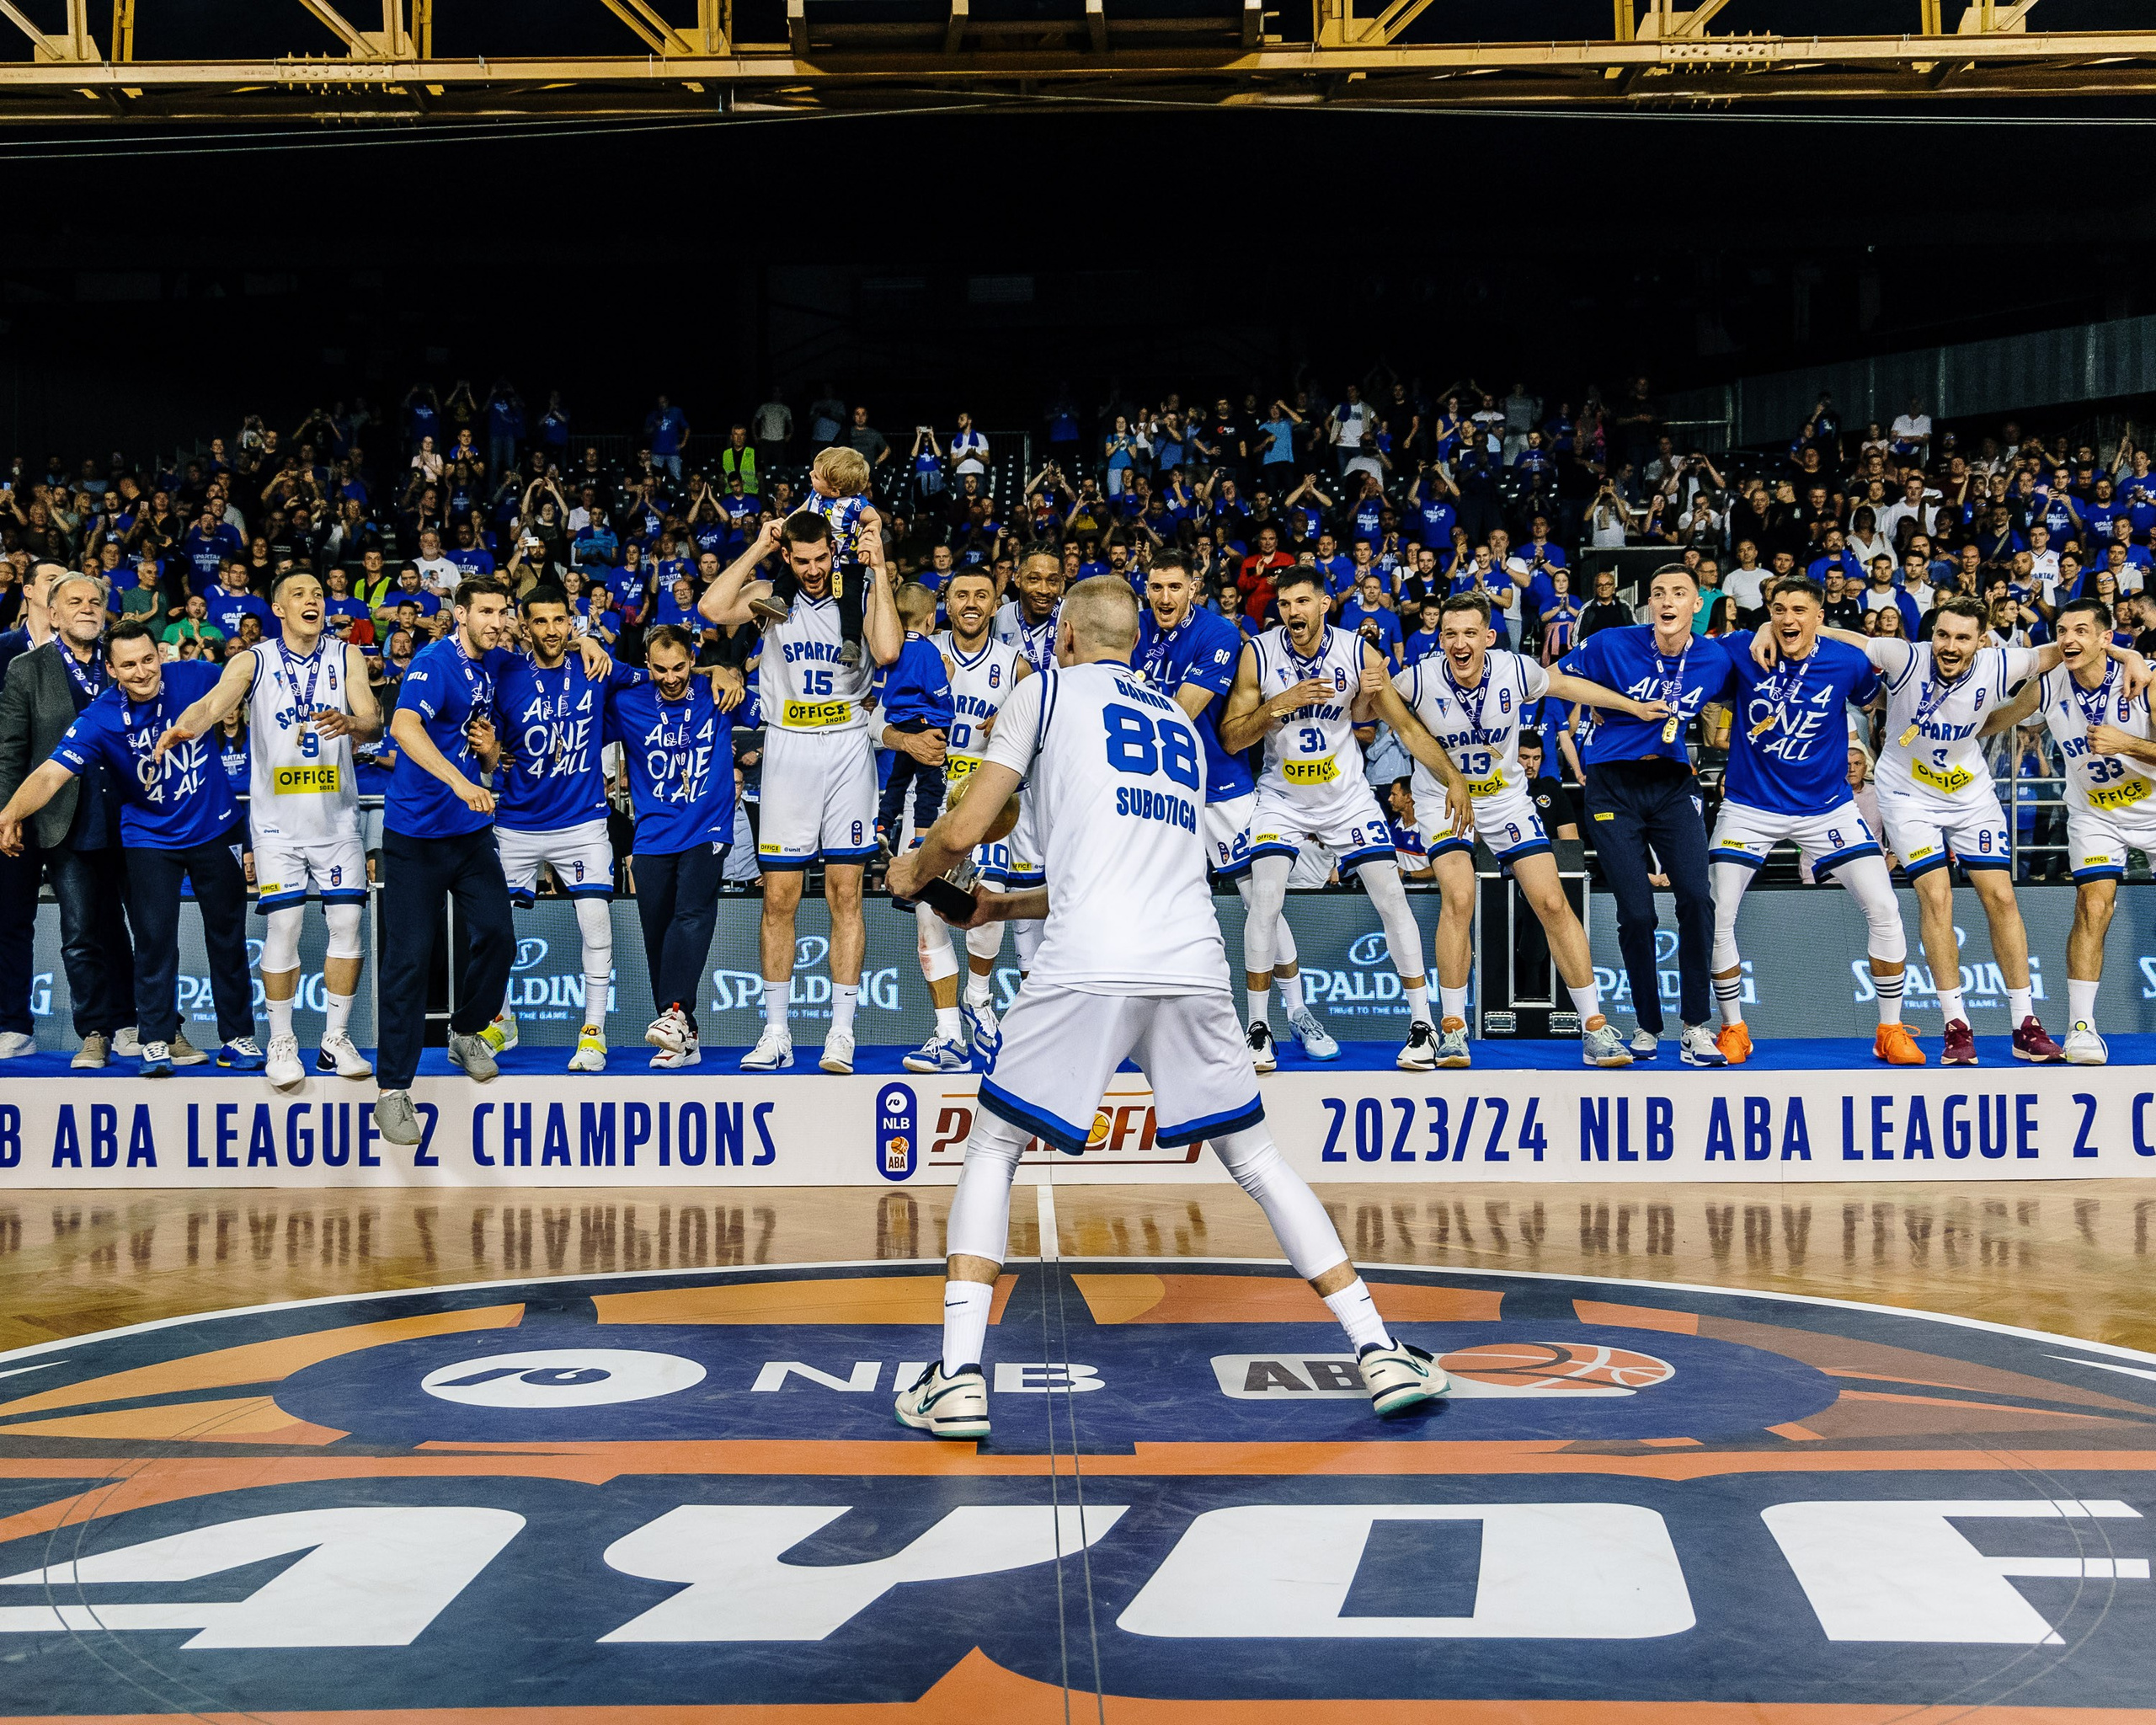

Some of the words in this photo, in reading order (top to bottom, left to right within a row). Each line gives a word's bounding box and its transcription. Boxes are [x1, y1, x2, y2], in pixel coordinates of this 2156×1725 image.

[1214, 649, 1231, 665] 88
[803, 669, 834, 697] 15
[576, 689, 593, 714] 4
[1680, 686, 1704, 708] 4
[1811, 684, 1834, 709] 4
[789, 704, 846, 719] OFFICE
[524, 715, 594, 757] ONE
[696, 718, 714, 744] 4
[946, 723, 972, 749] 0
[1299, 727, 1327, 753] 31
[302, 731, 320, 759] 9
[1102, 702, 1200, 793] 88
[1762, 737, 1812, 761] ALL
[526, 756, 545, 780] 4
[549, 749, 591, 778] ALL
[647, 745, 713, 780] ONE
[1284, 759, 1333, 777] OFFICE
[1460, 751, 1492, 775] 13
[1931, 748, 1949, 768] 3
[2086, 756, 2126, 783] 33
[279, 769, 336, 786] OFFICE
[1918, 764, 1970, 788] OFFICE
[147, 783, 166, 804] 4
[653, 781, 665, 803] 4
[1116, 786, 1197, 836] SUBOTICA
[760, 843, 779, 852] OFFICE
[978, 842, 1010, 870] 10
[1909, 846, 1931, 859] OFFICE
[51, 1103, 158, 1168] ABA
[187, 1103, 382, 1167] LEAGUE
[414, 1103, 440, 1167] 2
[472, 1102, 776, 1167] CHAMPIONS
[883, 1117, 910, 1130] NLB
[1321, 1097, 1548, 1163] 2023/24
[1580, 1096, 1674, 1162] NLB
[1705, 1096, 1812, 1162] ABA
[1842, 1094, 2039, 1161] LEAGUE
[2072, 1092, 2099, 1159] 2
[2132, 1092, 2156, 1156] C
[888, 1156, 906, 1169] ABA
